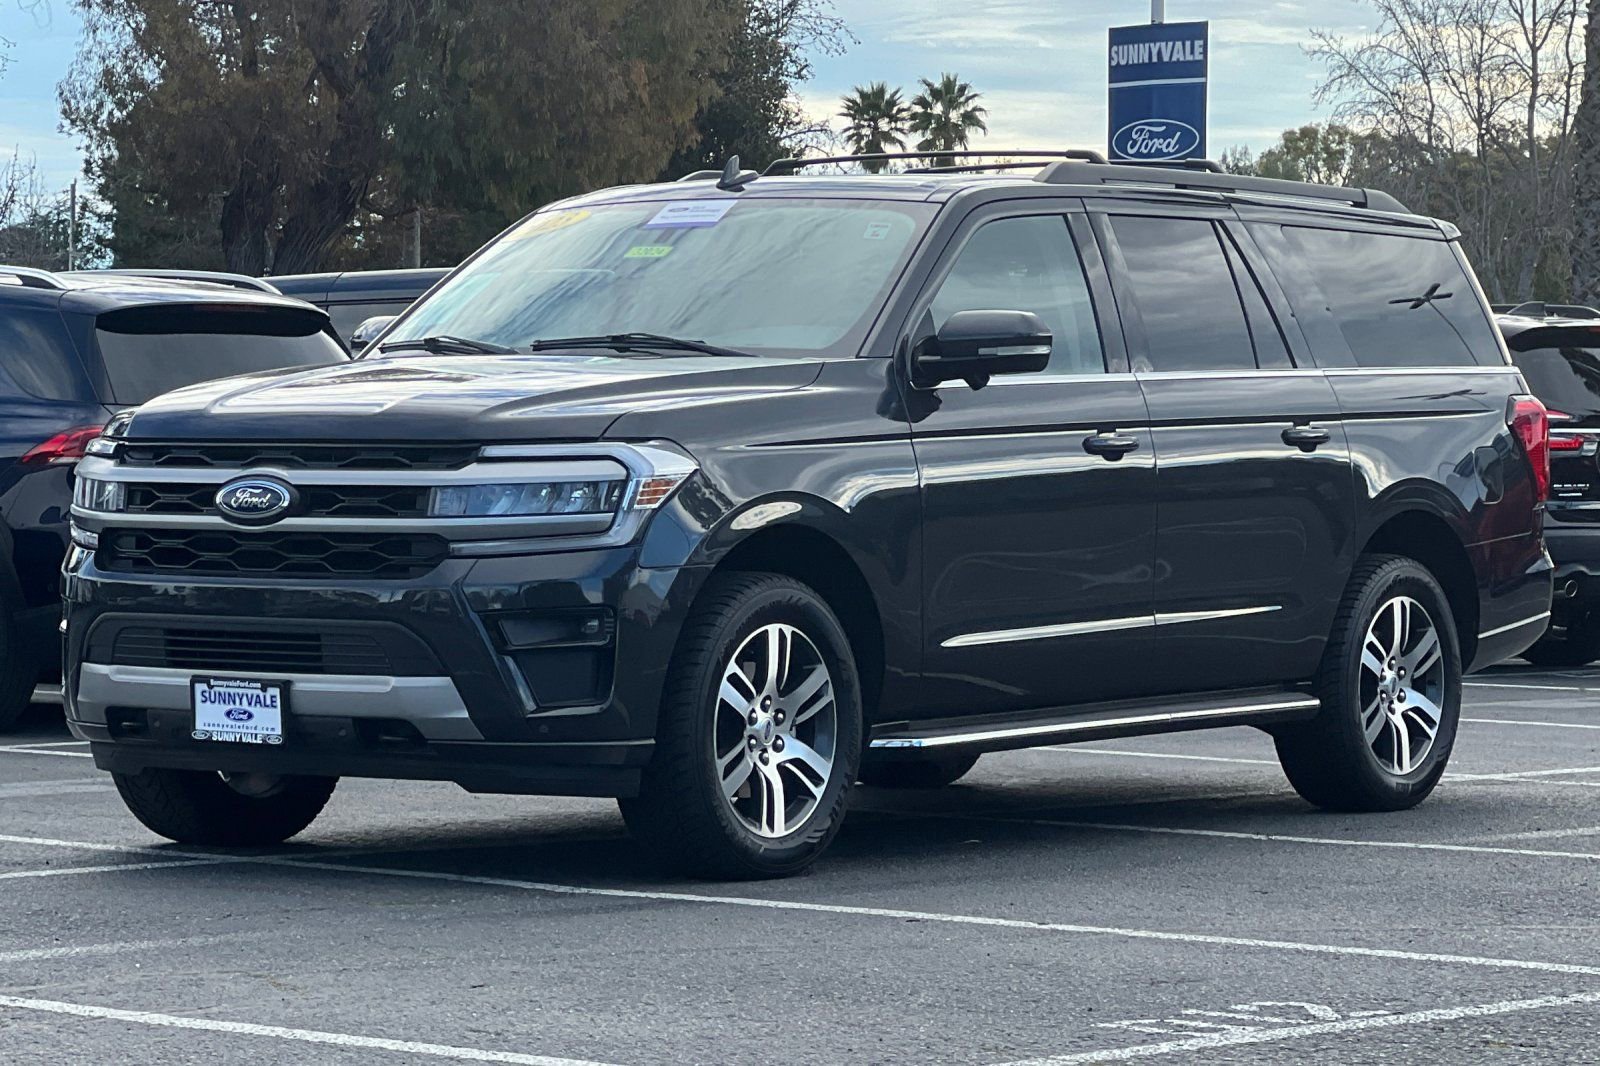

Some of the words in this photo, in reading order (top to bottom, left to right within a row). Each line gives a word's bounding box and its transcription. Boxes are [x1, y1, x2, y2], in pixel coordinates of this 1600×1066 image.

[1110, 40, 1204, 66] SUNNYVALE
[1127, 125, 1181, 155] Ford
[231, 487, 271, 508] Ford
[201, 690, 277, 708] SUNNYVALE
[229, 708, 249, 720] Ford
[211, 731, 263, 744] SUNNYVALE
